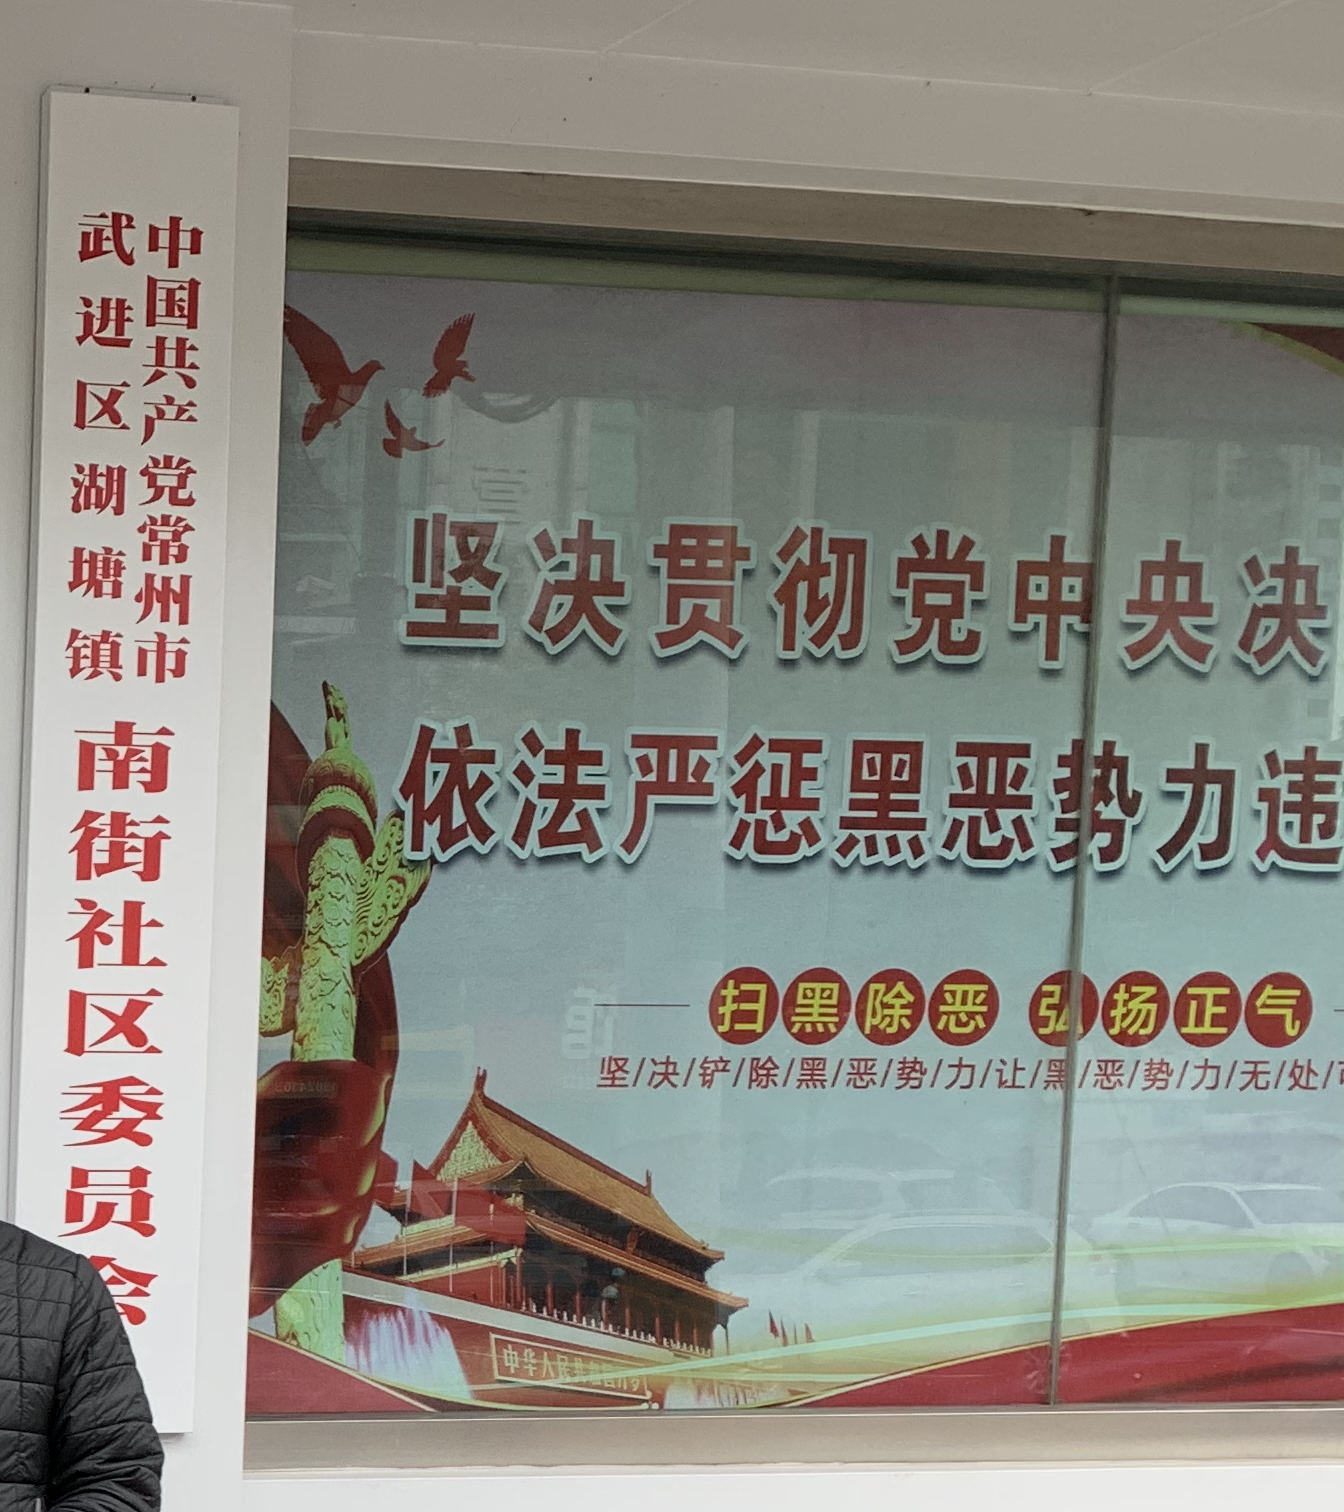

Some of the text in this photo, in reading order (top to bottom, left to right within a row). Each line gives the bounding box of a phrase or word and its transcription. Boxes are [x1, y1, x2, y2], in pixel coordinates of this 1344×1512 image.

[65, 211, 137, 683] 武进区湖塘镇
[134, 215, 204, 684] 中国共产党常州市
[406, 510, 1330, 670] 坚决贯彻党中央决
[399, 721, 1344, 868] 依法严惩黑恶势力违
[716, 979, 990, 1036] 扫黑除恶
